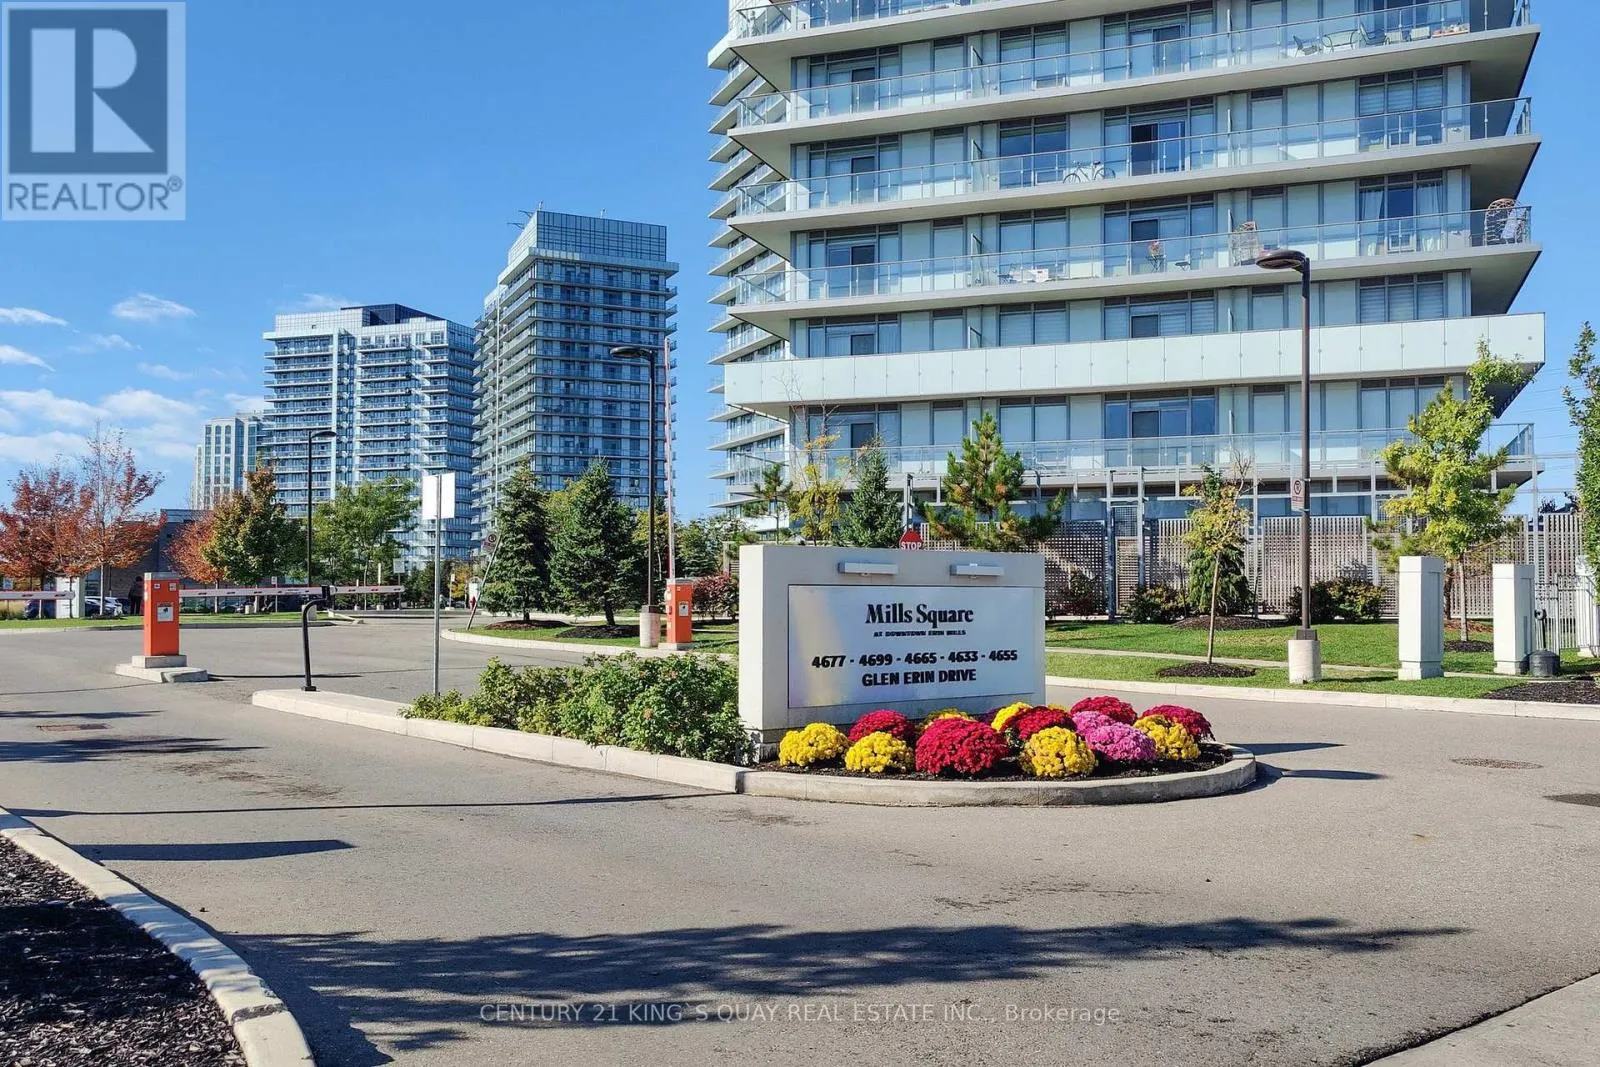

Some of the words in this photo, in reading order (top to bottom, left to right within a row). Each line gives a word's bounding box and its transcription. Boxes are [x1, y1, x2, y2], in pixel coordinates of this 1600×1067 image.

[900, 541, 922, 550] STOP
[865, 603, 912, 624] Mills
[916, 603, 974, 629] Square
[811, 655, 847, 668] 4677
[859, 653, 893, 666] 4699
[904, 652, 937, 664] 4665
[948, 651, 979, 663] 4633
[988, 650, 1018, 661] 4655
[861, 672, 900, 687] GLEN
[903, 670, 935, 684] ERIN
[938, 669, 977, 683] DRIVE
